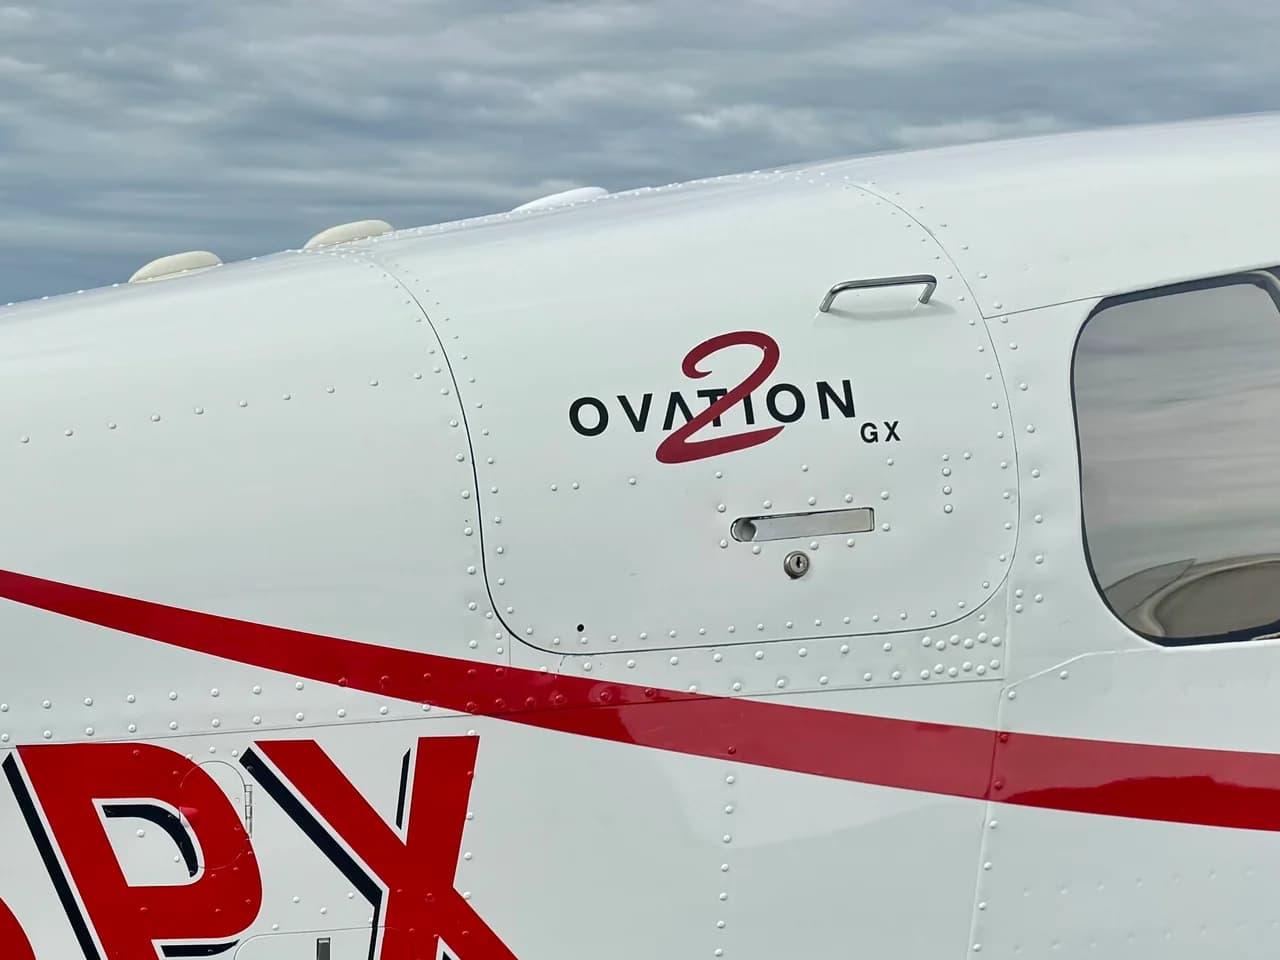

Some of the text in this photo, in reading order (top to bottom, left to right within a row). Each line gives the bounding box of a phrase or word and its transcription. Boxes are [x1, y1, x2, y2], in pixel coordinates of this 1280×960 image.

[568, 379, 856, 437] OVATION
[656, 331, 780, 464] 2
[860, 421, 901, 443] GX
